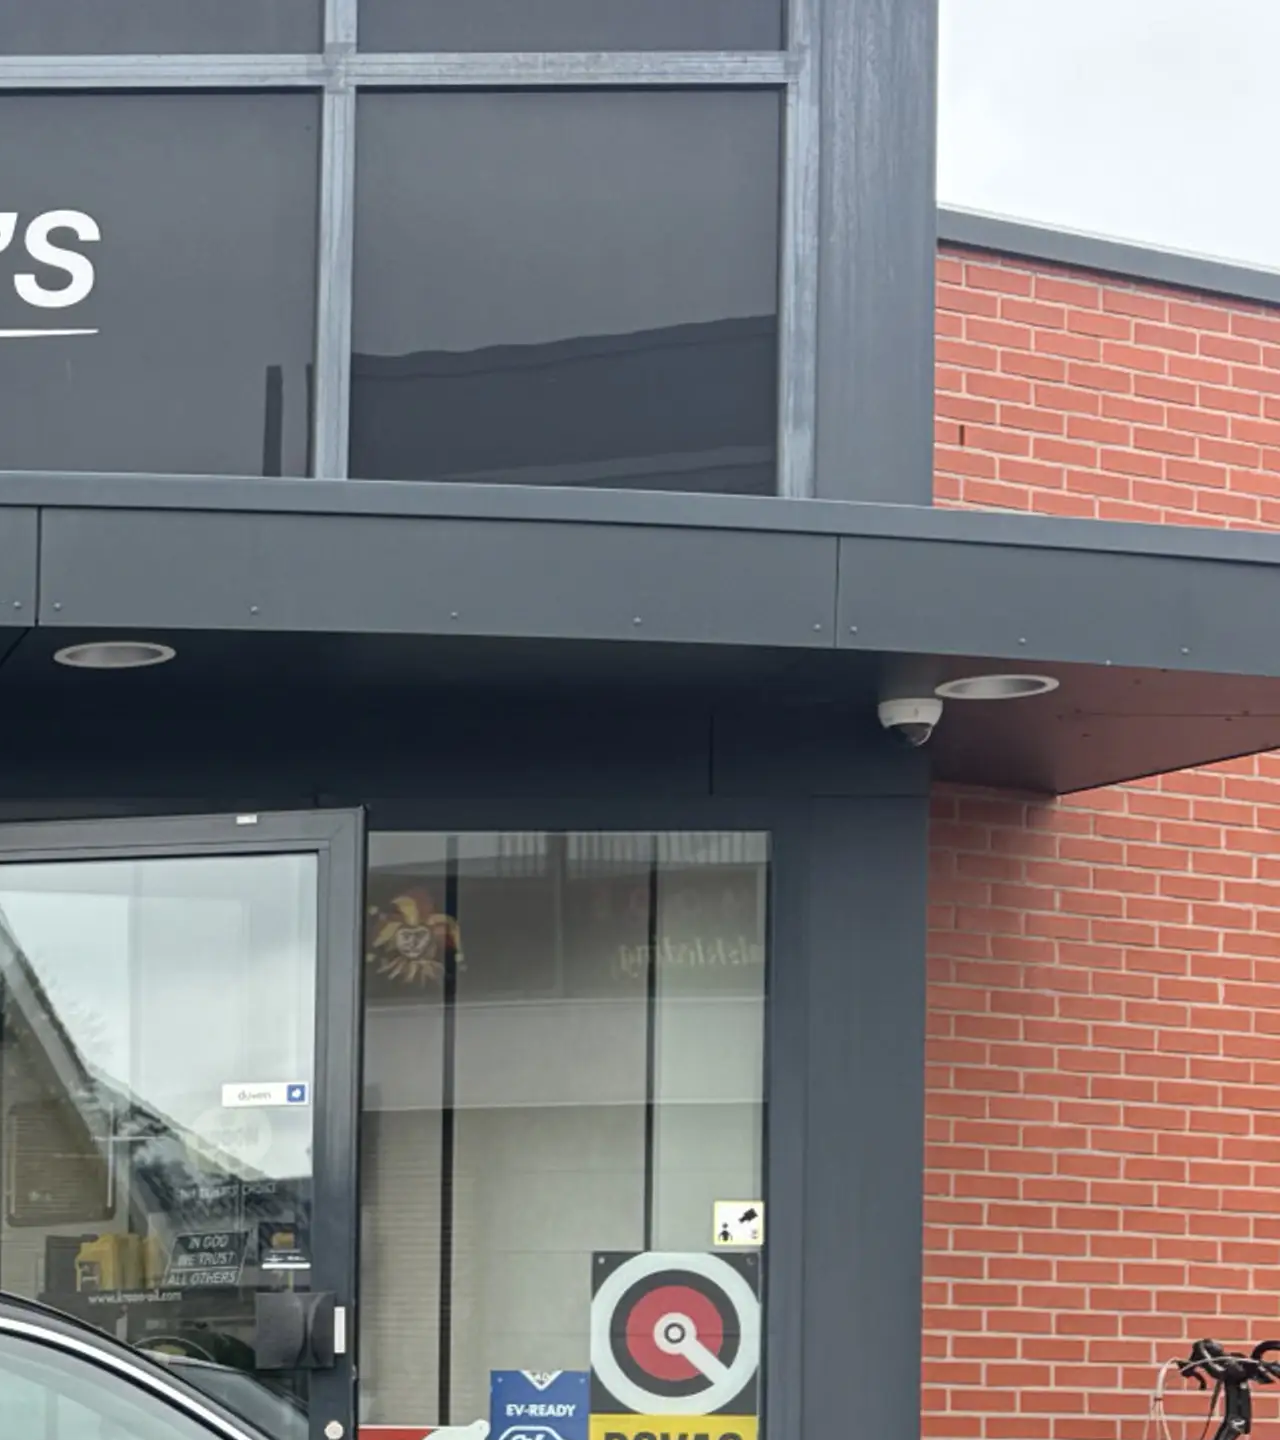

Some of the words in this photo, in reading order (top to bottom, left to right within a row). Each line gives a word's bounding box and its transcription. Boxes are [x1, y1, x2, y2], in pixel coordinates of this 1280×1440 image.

[203, 1236, 229, 1248] GOD
[199, 1252, 236, 1265] TRUST
[190, 1271, 238, 1285] OTHERS
[505, 1404, 576, 1417] EV-READY
